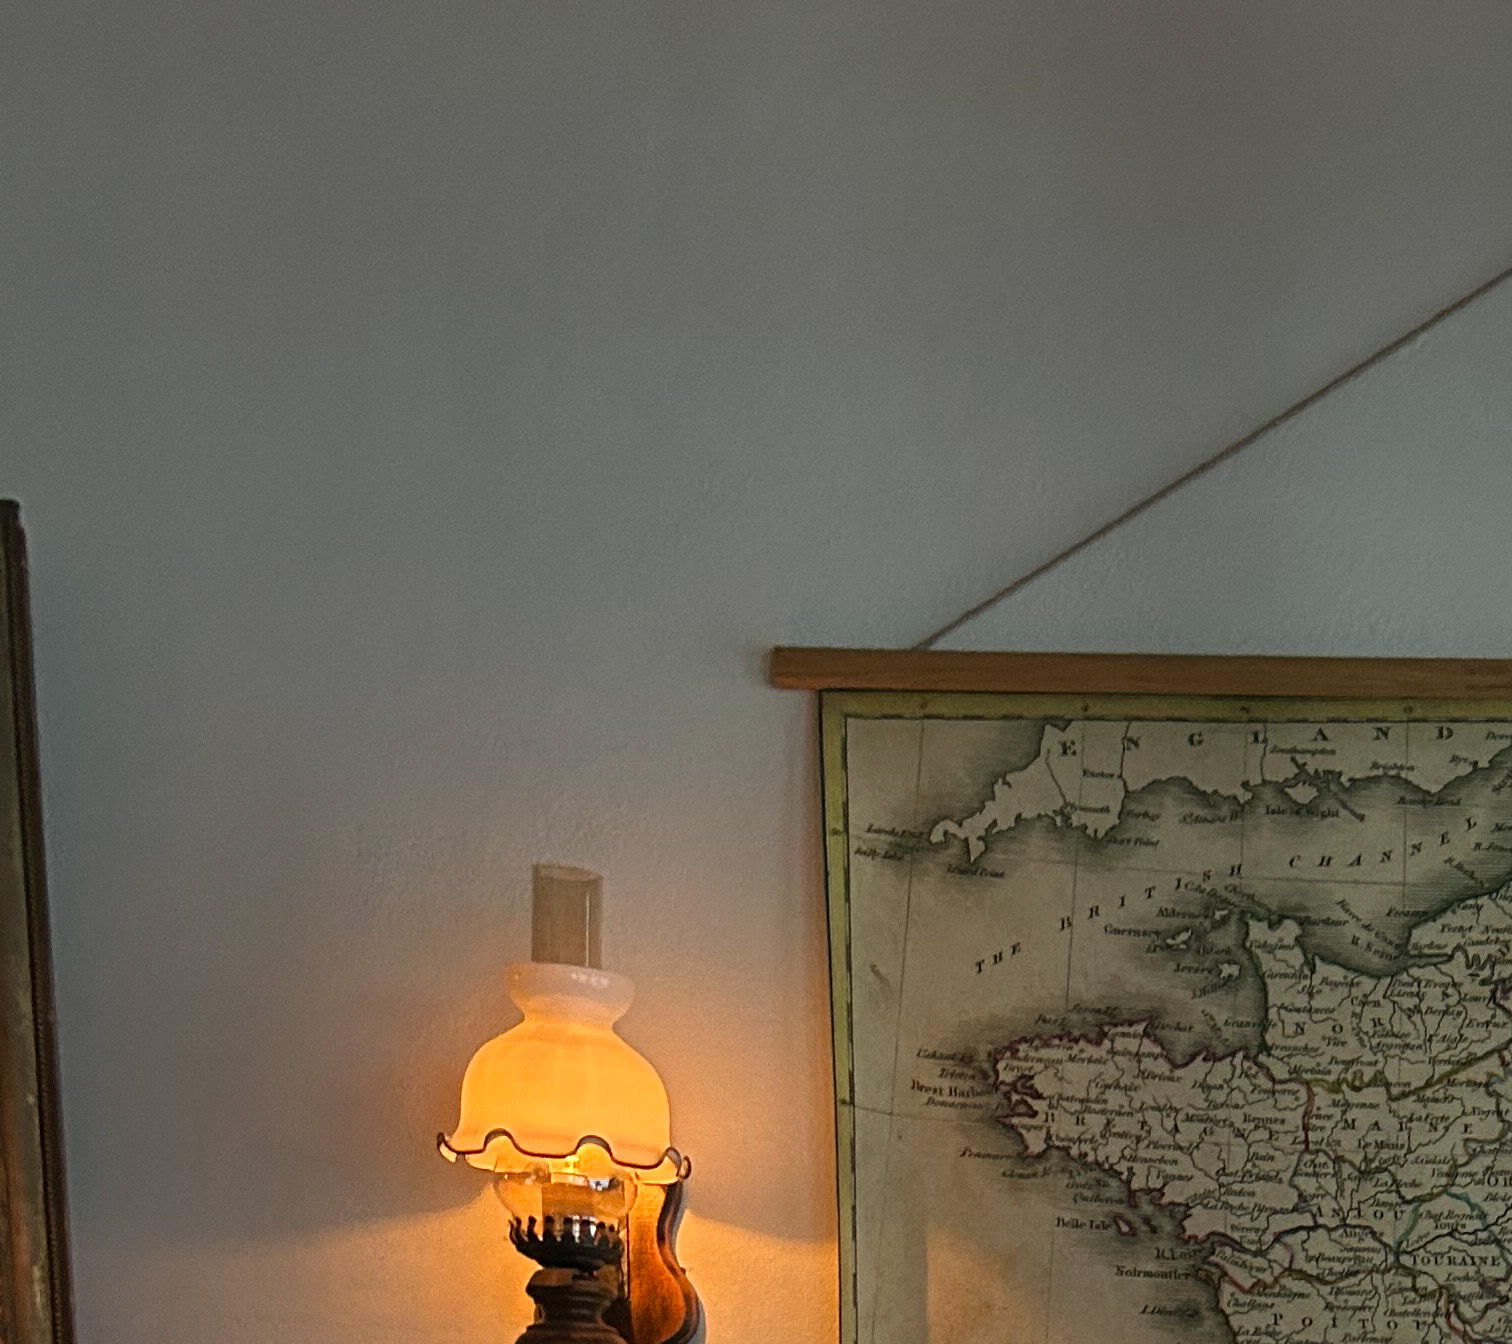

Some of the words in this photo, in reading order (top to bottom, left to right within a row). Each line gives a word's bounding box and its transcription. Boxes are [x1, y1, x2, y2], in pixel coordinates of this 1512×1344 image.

[1288, 816, 1478, 868] CHANNEL
[975, 941, 1023, 976] THE
[1411, 1254, 1501, 1268] TOURAINE
